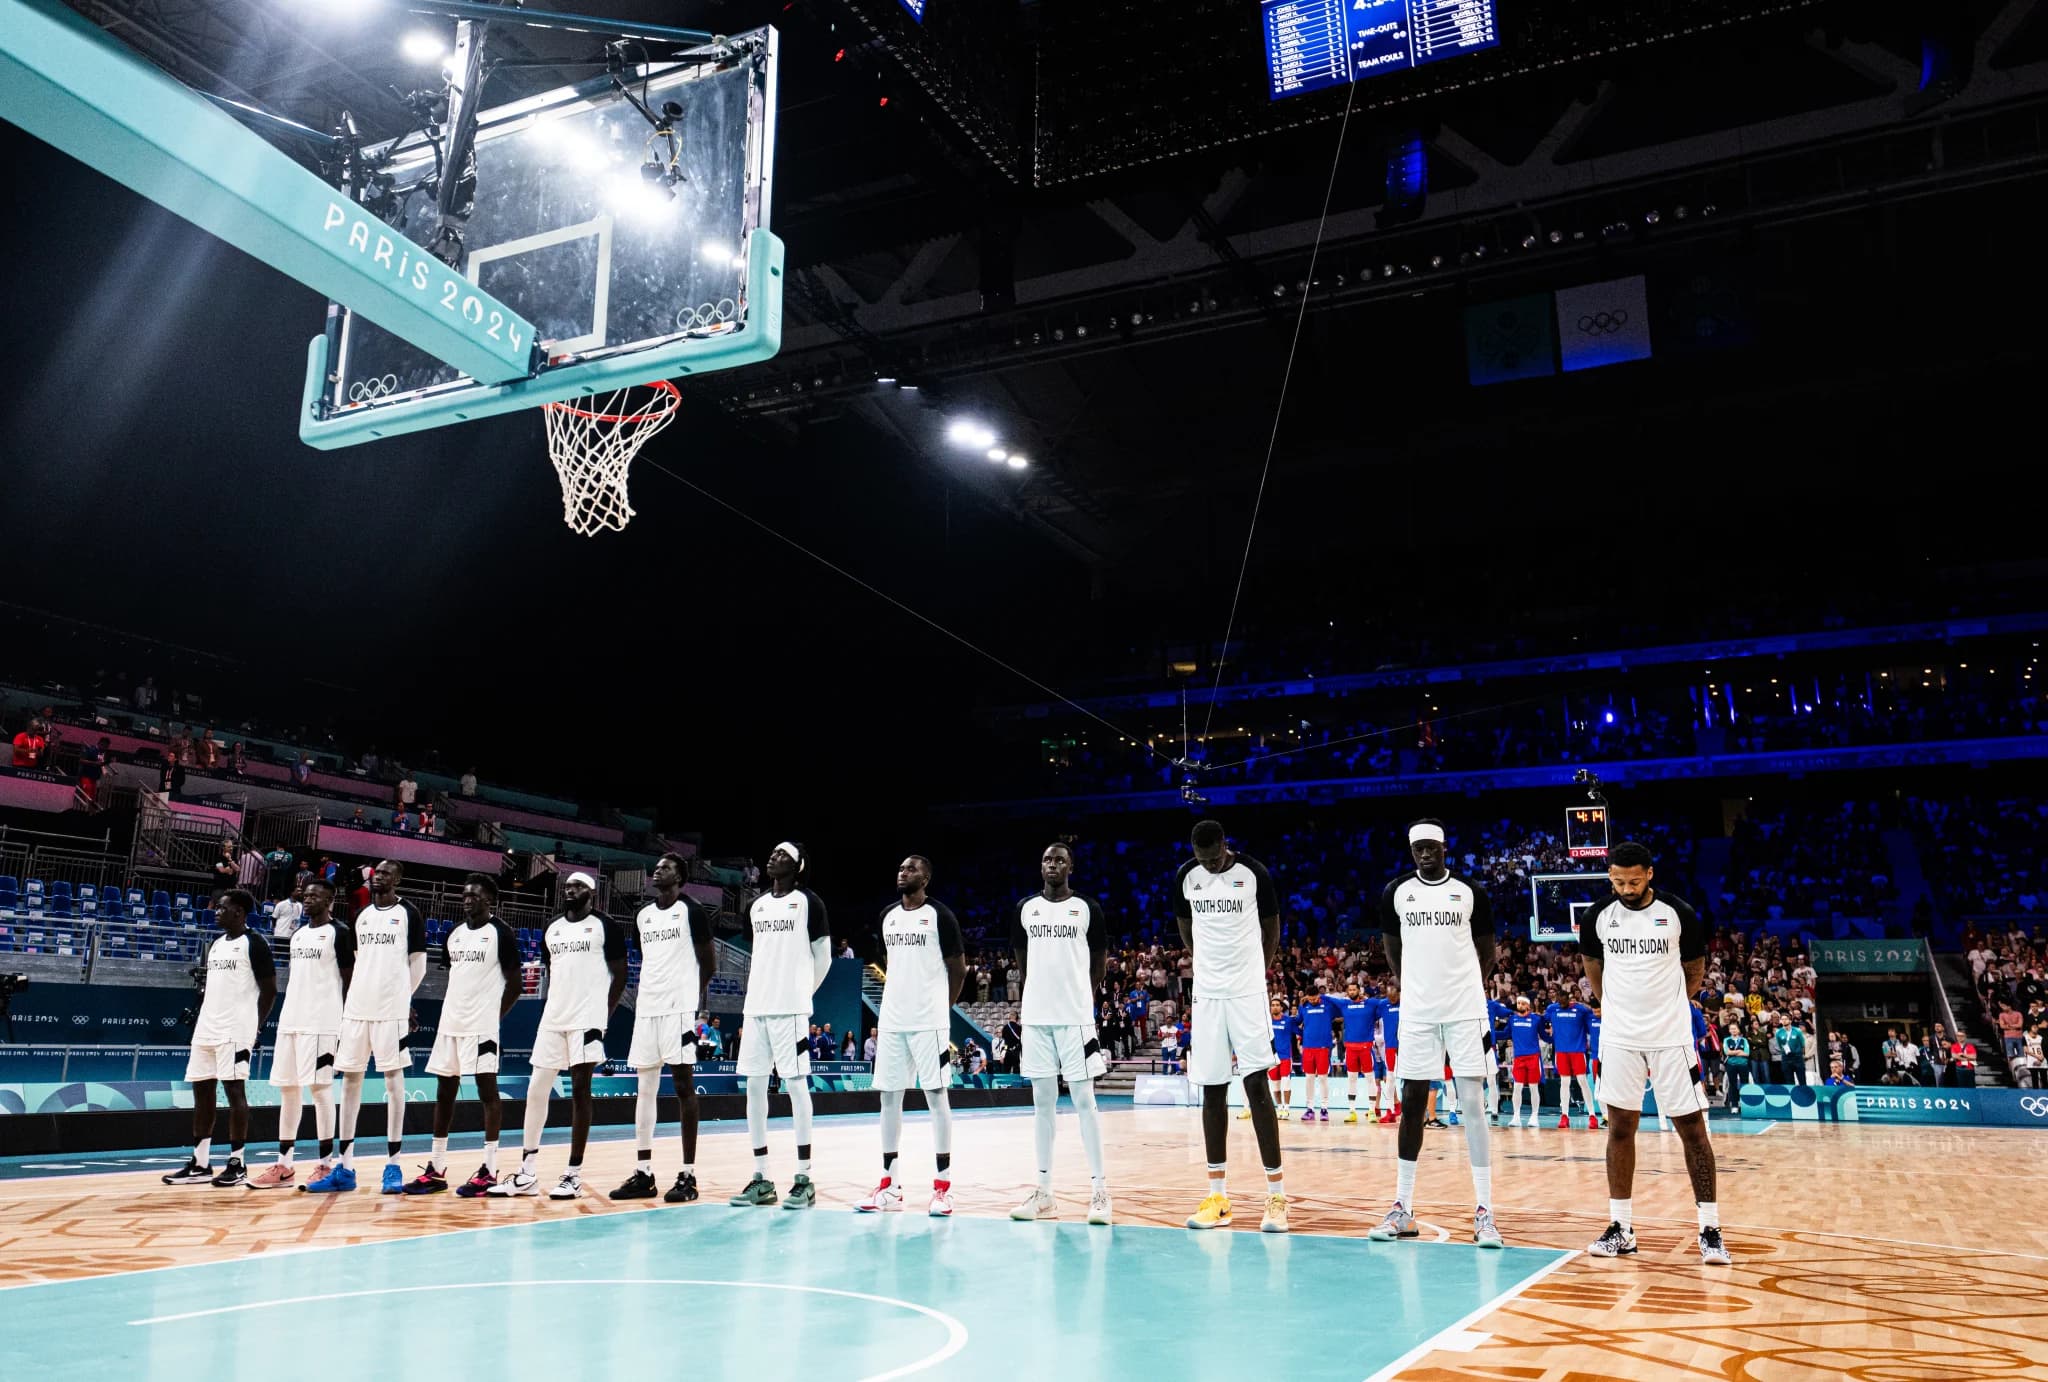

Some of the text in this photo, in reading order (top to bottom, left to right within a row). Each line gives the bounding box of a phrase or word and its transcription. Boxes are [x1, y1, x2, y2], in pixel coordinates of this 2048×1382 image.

[1357, 22, 1398, 38] TIME-OUTS
[1358, 51, 1404, 69] TEAM FOULS
[323, 202, 523, 353] PARIS 2024
[1192, 899, 1242, 914] SOUTH SUDAN
[754, 919, 795, 933] SOUTH SUDAN
[1405, 911, 1462, 927] SOUTH SUDAN
[375, 932, 396, 945] SUDAN
[643, 927, 681, 944] SOUTH SUDAN
[1029, 925, 1078, 939] SOUTH SUDAN
[885, 933, 927, 947] SOUTH SUDAN
[1608, 938, 1669, 955] SOUTH SUDAN
[550, 940, 591, 955] SOUTH SUDAN
[465, 950, 487, 963] SUDAN
[1811, 949, 1926, 963] PARIS 2024
[12, 1014, 59, 1024] ARIS 2024
[102, 1017, 150, 1025] PARIS 2024
[2032, 1047, 2042, 1055] 16
[1866, 1096, 1971, 1111] PARIS 2024
